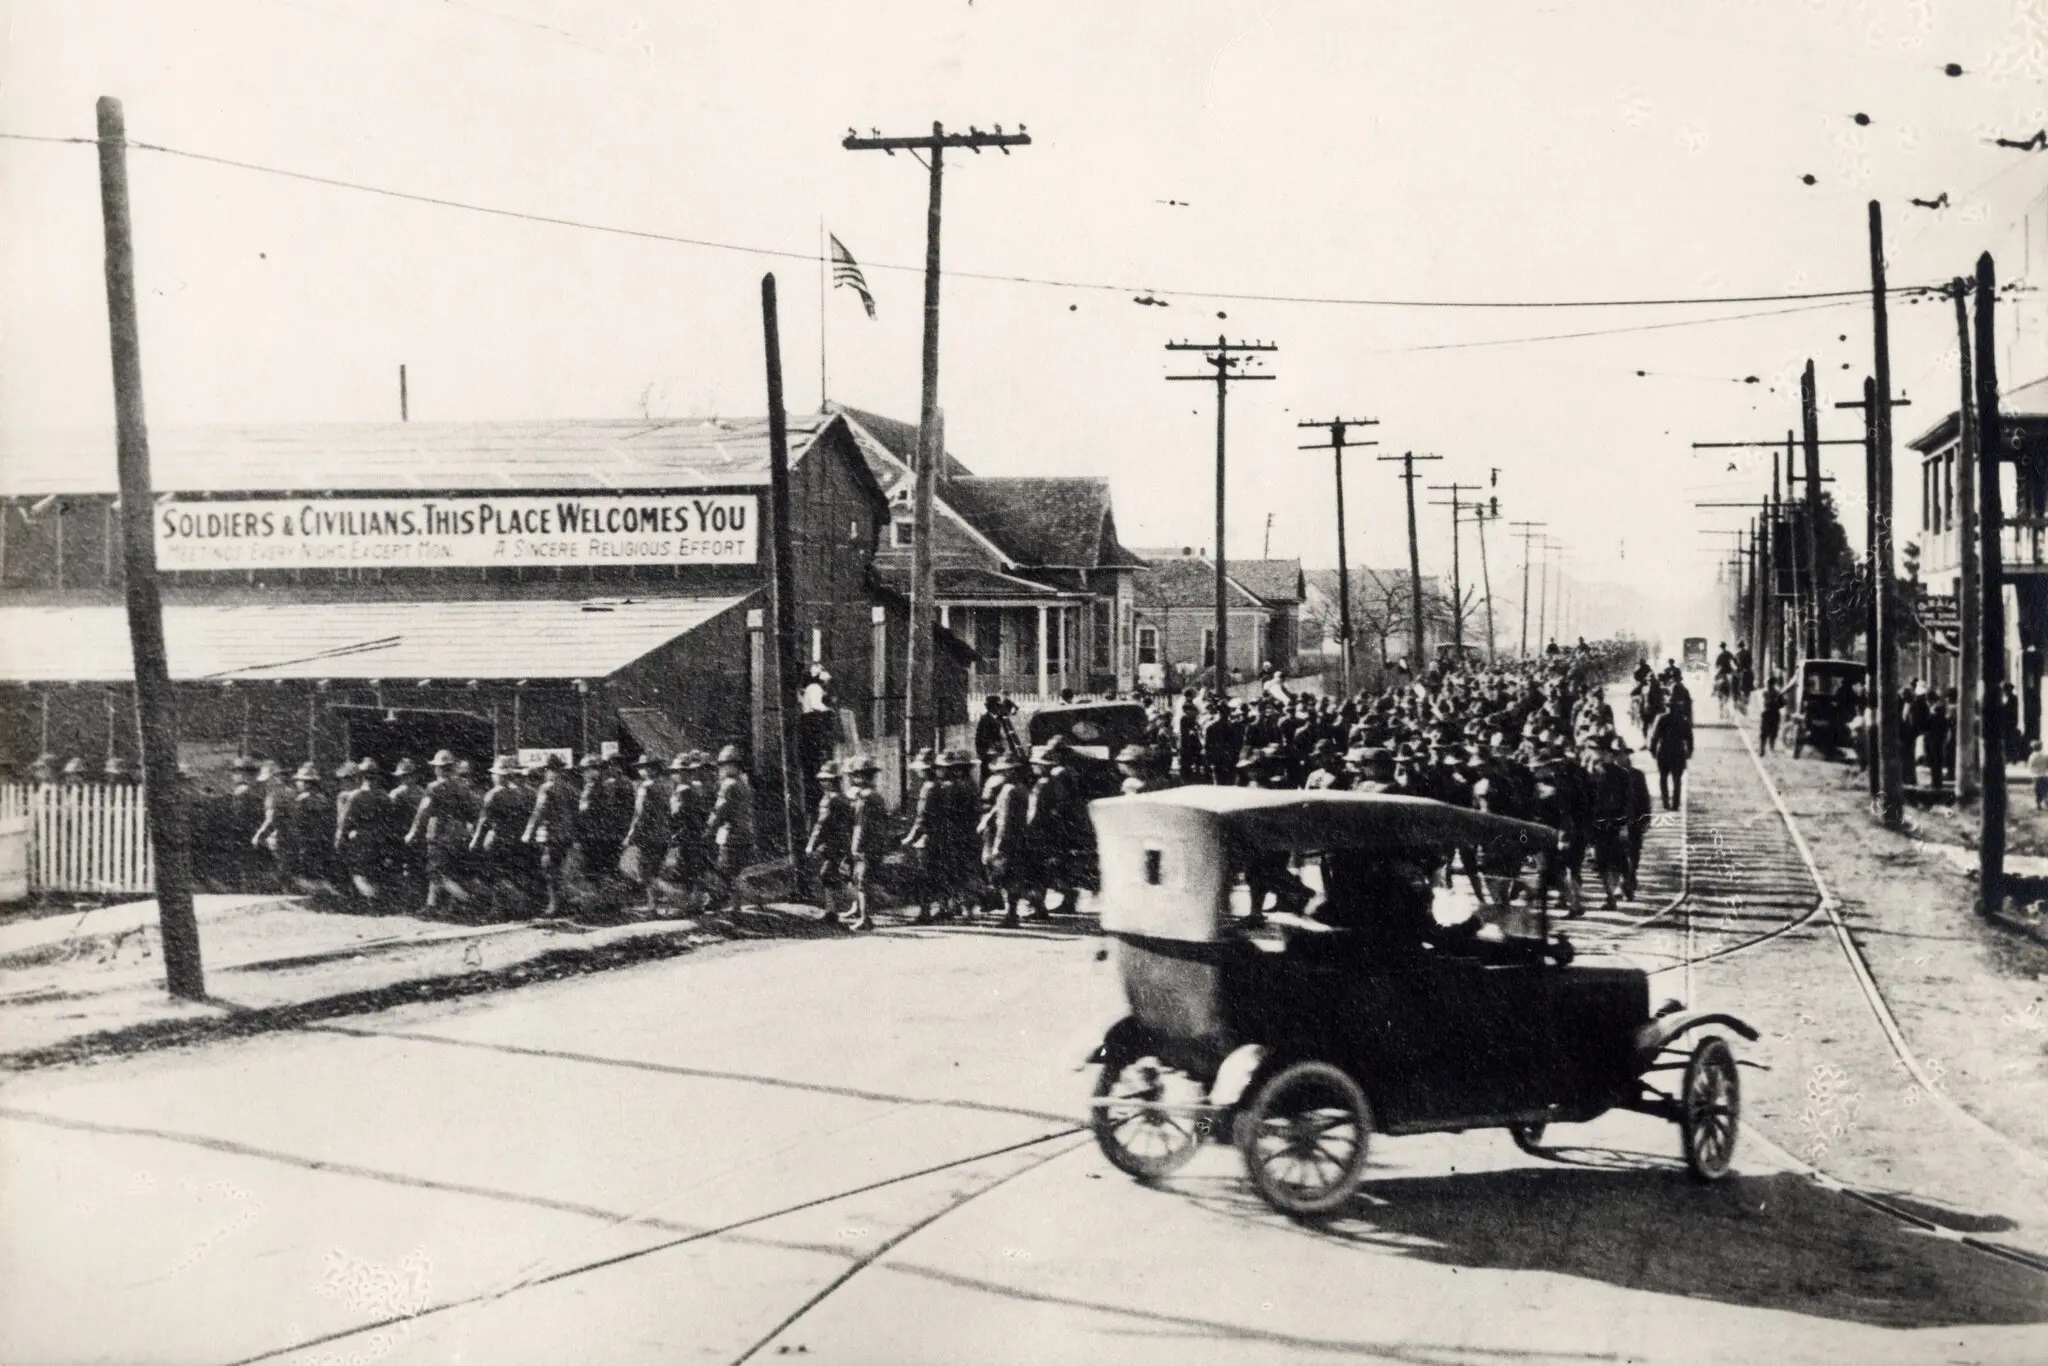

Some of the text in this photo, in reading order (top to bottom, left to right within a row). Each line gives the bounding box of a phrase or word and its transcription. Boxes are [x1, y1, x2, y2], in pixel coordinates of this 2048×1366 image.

[163, 508, 275, 539] SOLDIERS
[282, 515, 294, 536] &
[422, 504, 475, 534] THIS
[479, 503, 551, 535] PLACE
[556, 502, 688, 533] WELCOMES
[693, 500, 745, 531] YOU
[351, 540, 412, 560] EXCEPT
[590, 538, 671, 557] RELIGIOUS
[680, 537, 746, 556] EFFORT
